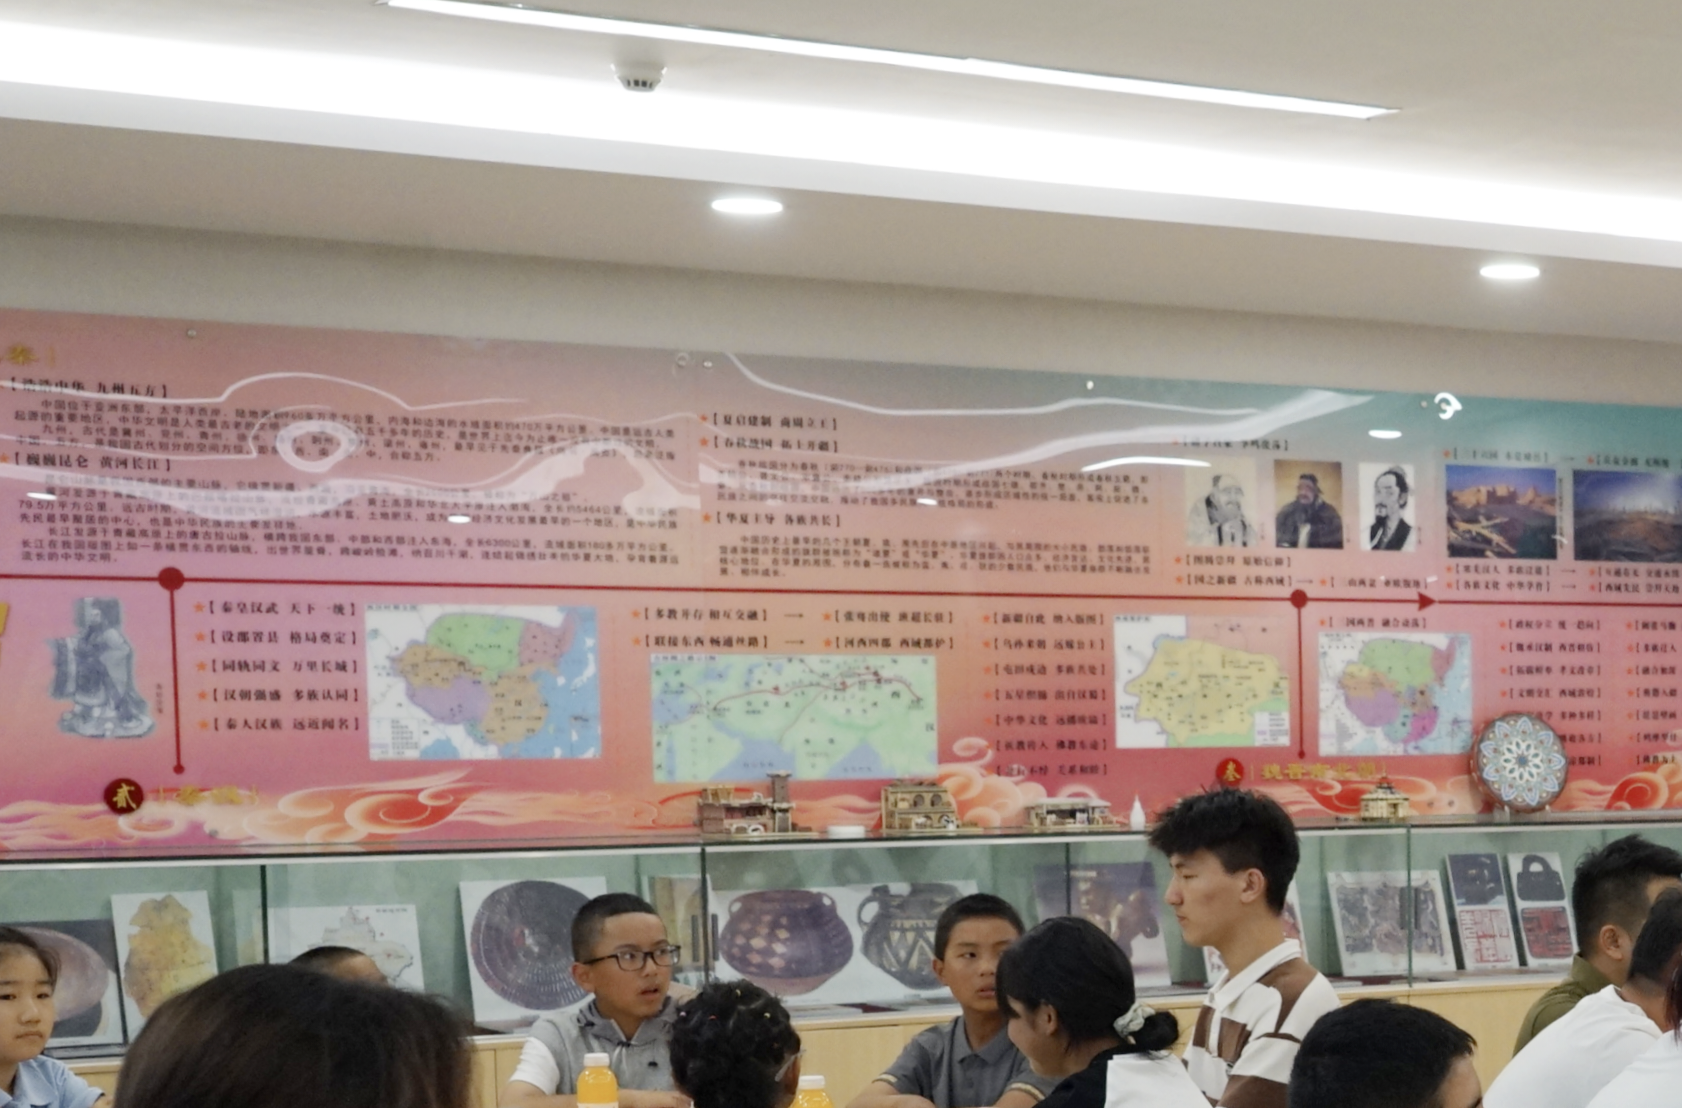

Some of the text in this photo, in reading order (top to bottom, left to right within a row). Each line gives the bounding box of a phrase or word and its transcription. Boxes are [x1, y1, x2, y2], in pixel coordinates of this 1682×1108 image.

[209, 600, 356, 615] 【秦皇汉武 天下一统】
[644, 607, 769, 622] 【多教并存 相互交融】
[1053, 611, 1104, 626] 纳入版图】
[210, 629, 357, 645] 【设郡置县 格局奠定】
[645, 634, 769, 650] 【联接东西 畅通丝路】
[211, 658, 358, 674] 【同轨同文 万里长城】
[212, 688, 360, 703] 【汉朝强盛 多族认同】
[213, 716, 361, 732] 【秦人汉族 远近闻名】
[995, 713, 1048, 727] 【中华文化
[115, 782, 137, 810] 贰
